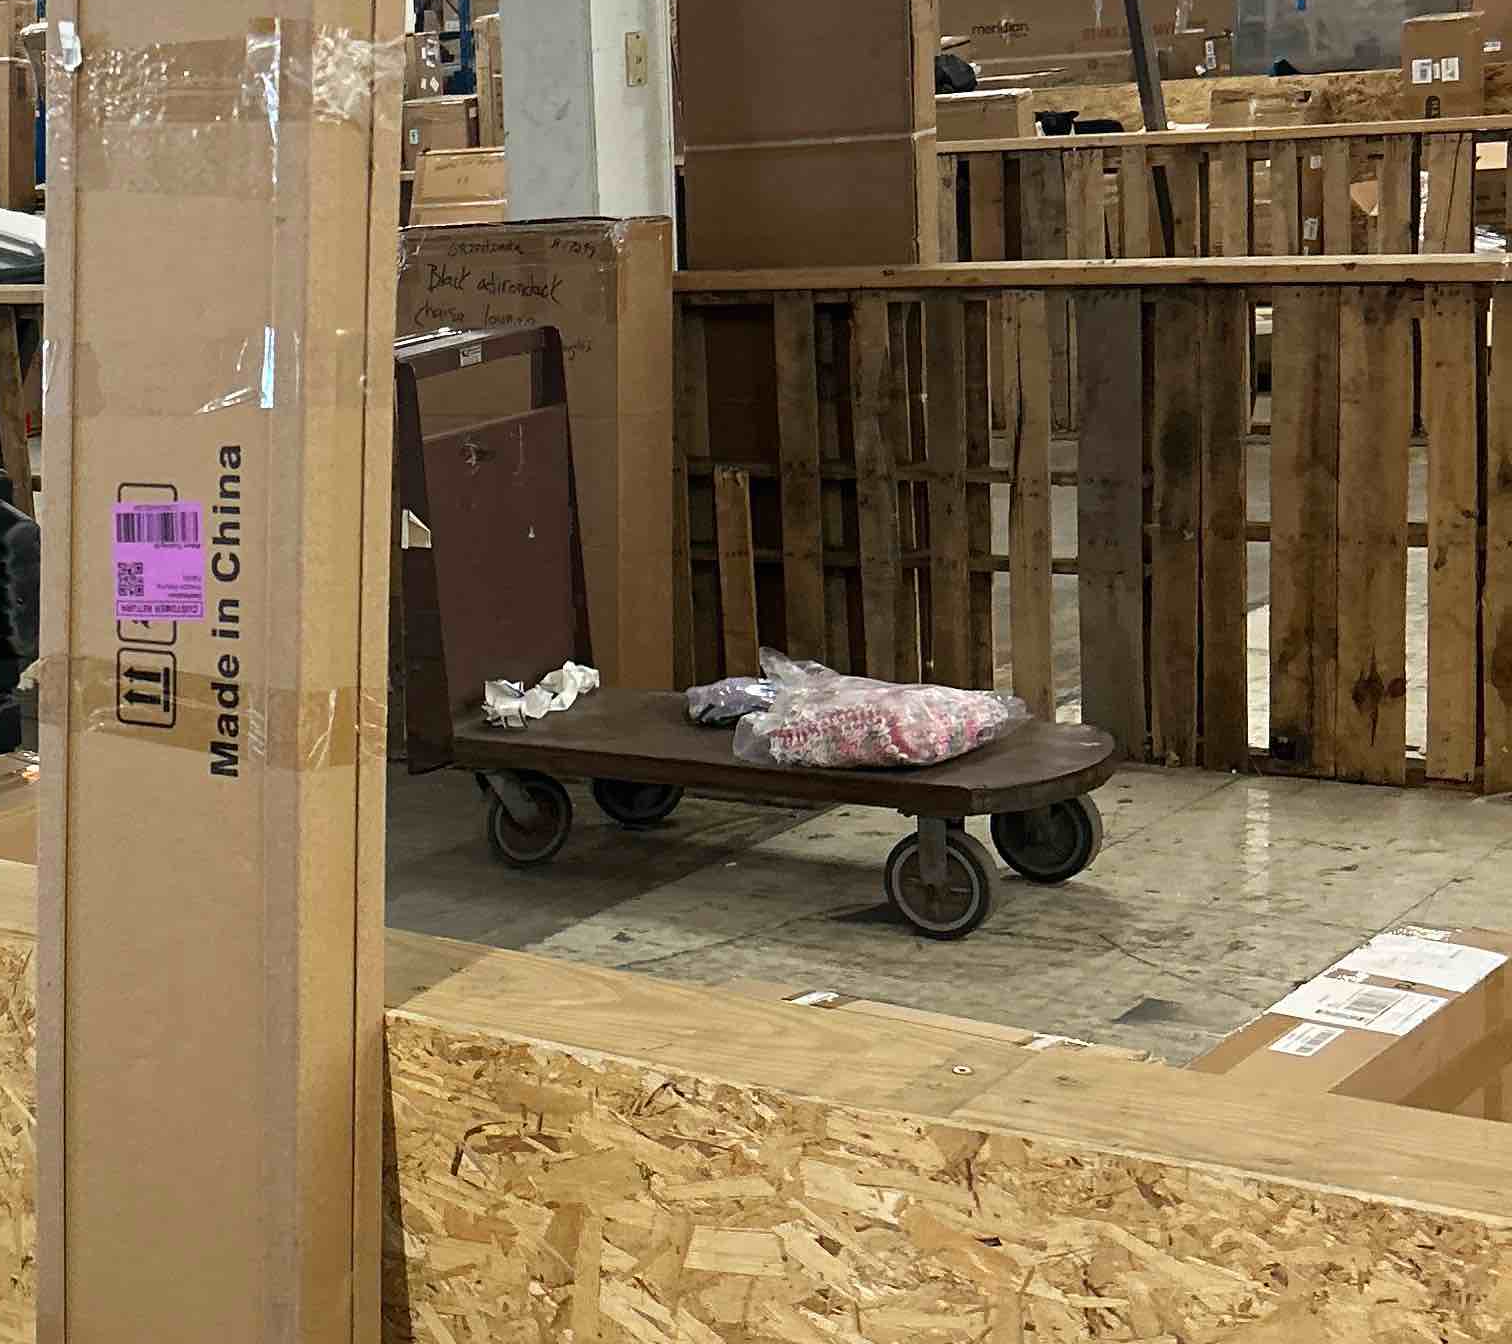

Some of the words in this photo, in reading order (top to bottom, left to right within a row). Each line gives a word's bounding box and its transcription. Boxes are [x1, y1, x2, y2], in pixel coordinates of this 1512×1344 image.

[211, 444, 241, 583] China
[211, 599, 239, 639] in
[211, 653, 239, 777] Made
